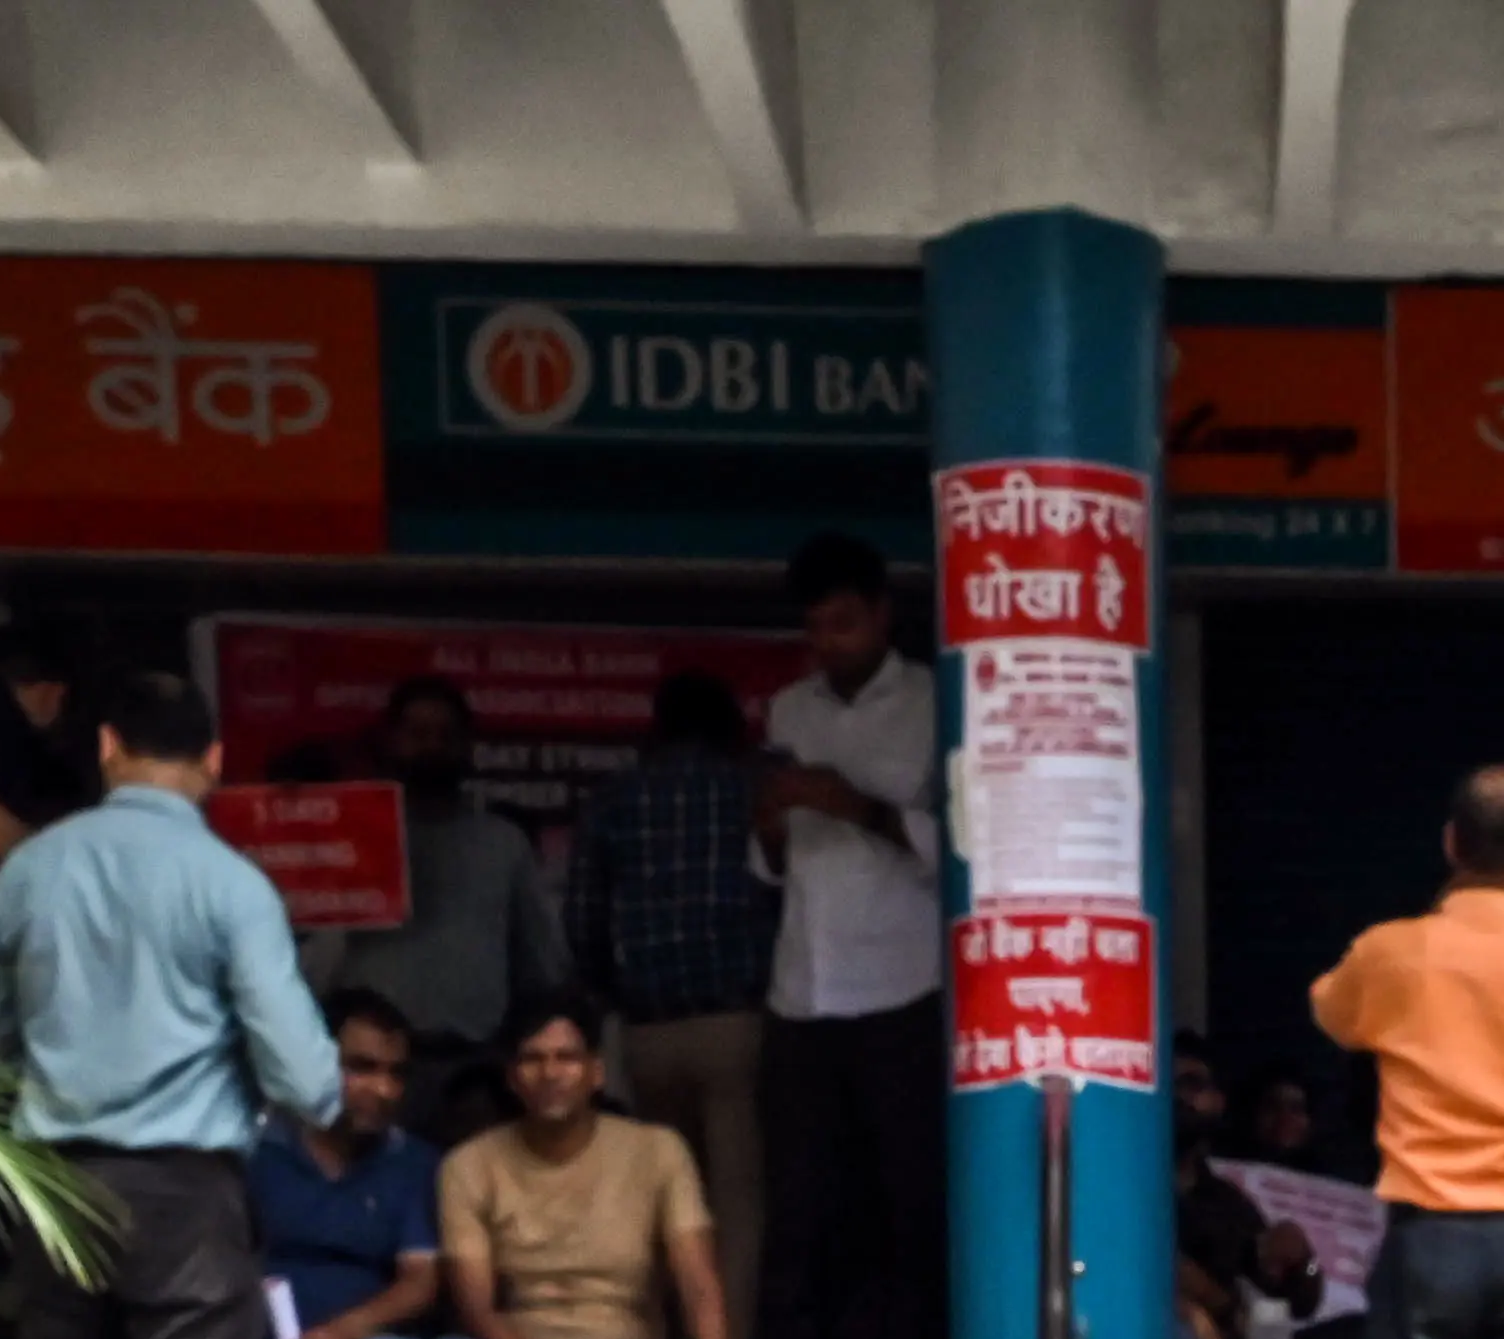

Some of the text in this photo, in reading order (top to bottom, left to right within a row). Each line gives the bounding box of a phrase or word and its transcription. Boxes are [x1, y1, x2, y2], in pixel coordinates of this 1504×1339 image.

[76, 287, 331, 448] बैंक
[610, 336, 934, 415] IDBI BAN
